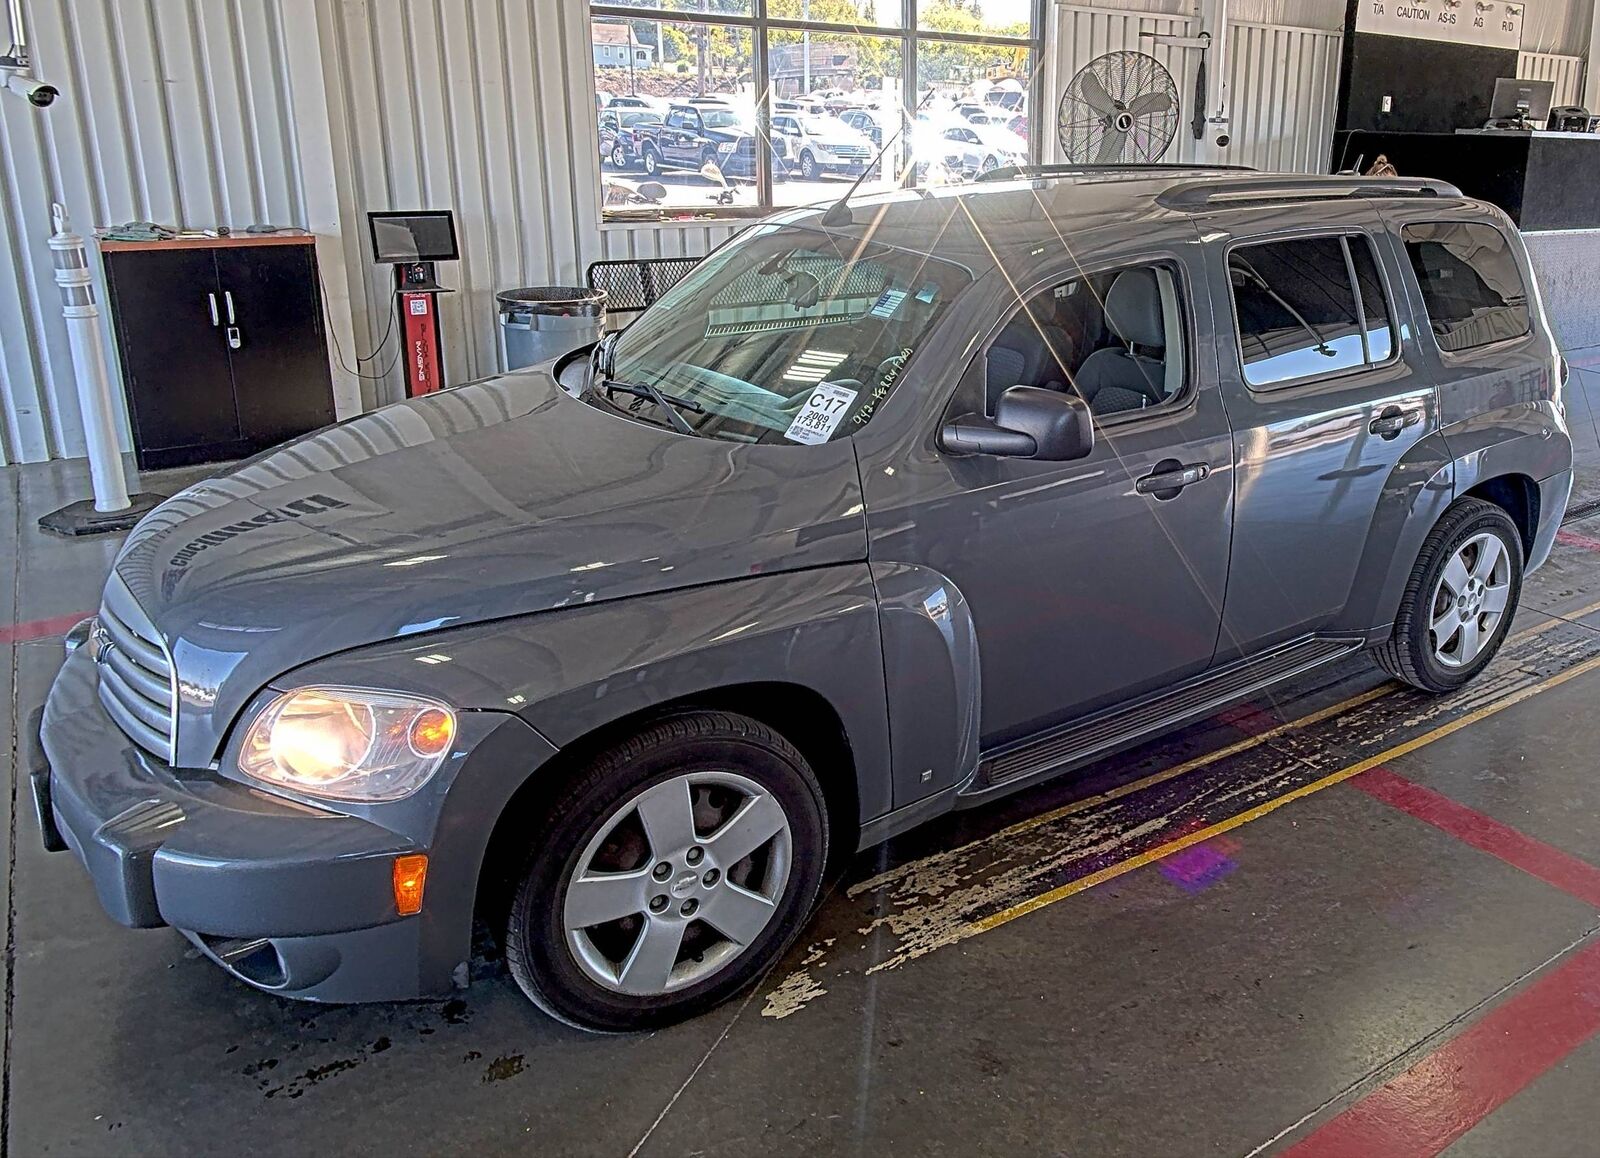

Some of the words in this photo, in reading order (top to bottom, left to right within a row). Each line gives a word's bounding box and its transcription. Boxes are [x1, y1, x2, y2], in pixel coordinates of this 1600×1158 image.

[1373, 2, 1385, 15] T/A
[1396, 6, 1430, 20] CAUTION
[1437, 12, 1457, 25] AS-IS
[1473, 17, 1484, 28] AG
[415, 340, 425, 381] IMAGING
[808, 393, 847, 415] C17
[806, 410, 830, 423] 2009
[796, 415, 832, 433] 173,811
